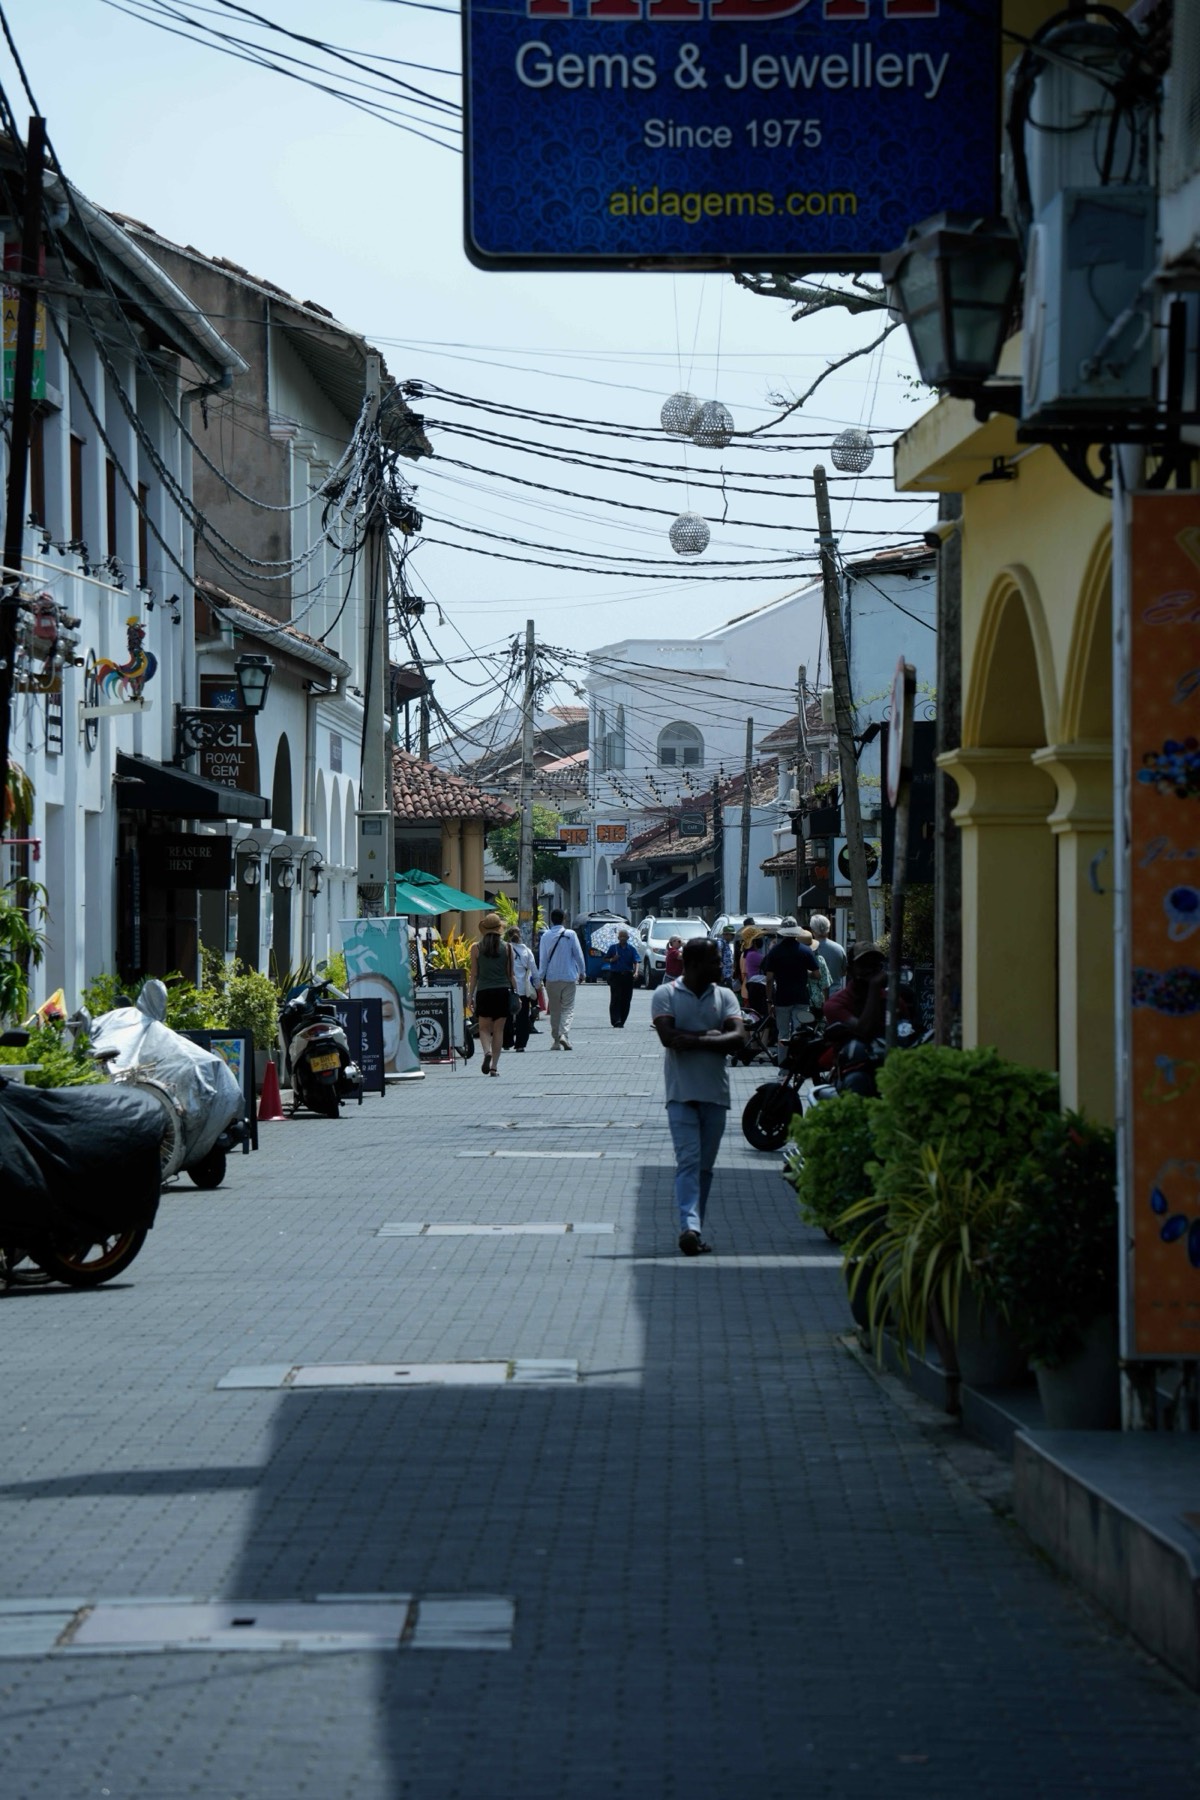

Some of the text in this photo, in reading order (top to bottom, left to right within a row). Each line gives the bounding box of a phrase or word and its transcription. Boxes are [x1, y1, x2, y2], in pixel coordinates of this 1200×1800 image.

[515, 41, 950, 98] Gems & Jewellery
[644, 119, 822, 149] Since 1975
[609, 187, 858, 223] aidagems.com
[205, 753, 246, 764] ROYAL
[211, 766, 240, 777] GEM
[165, 846, 213, 858] REASURE
[167, 859, 194, 871] HEST
